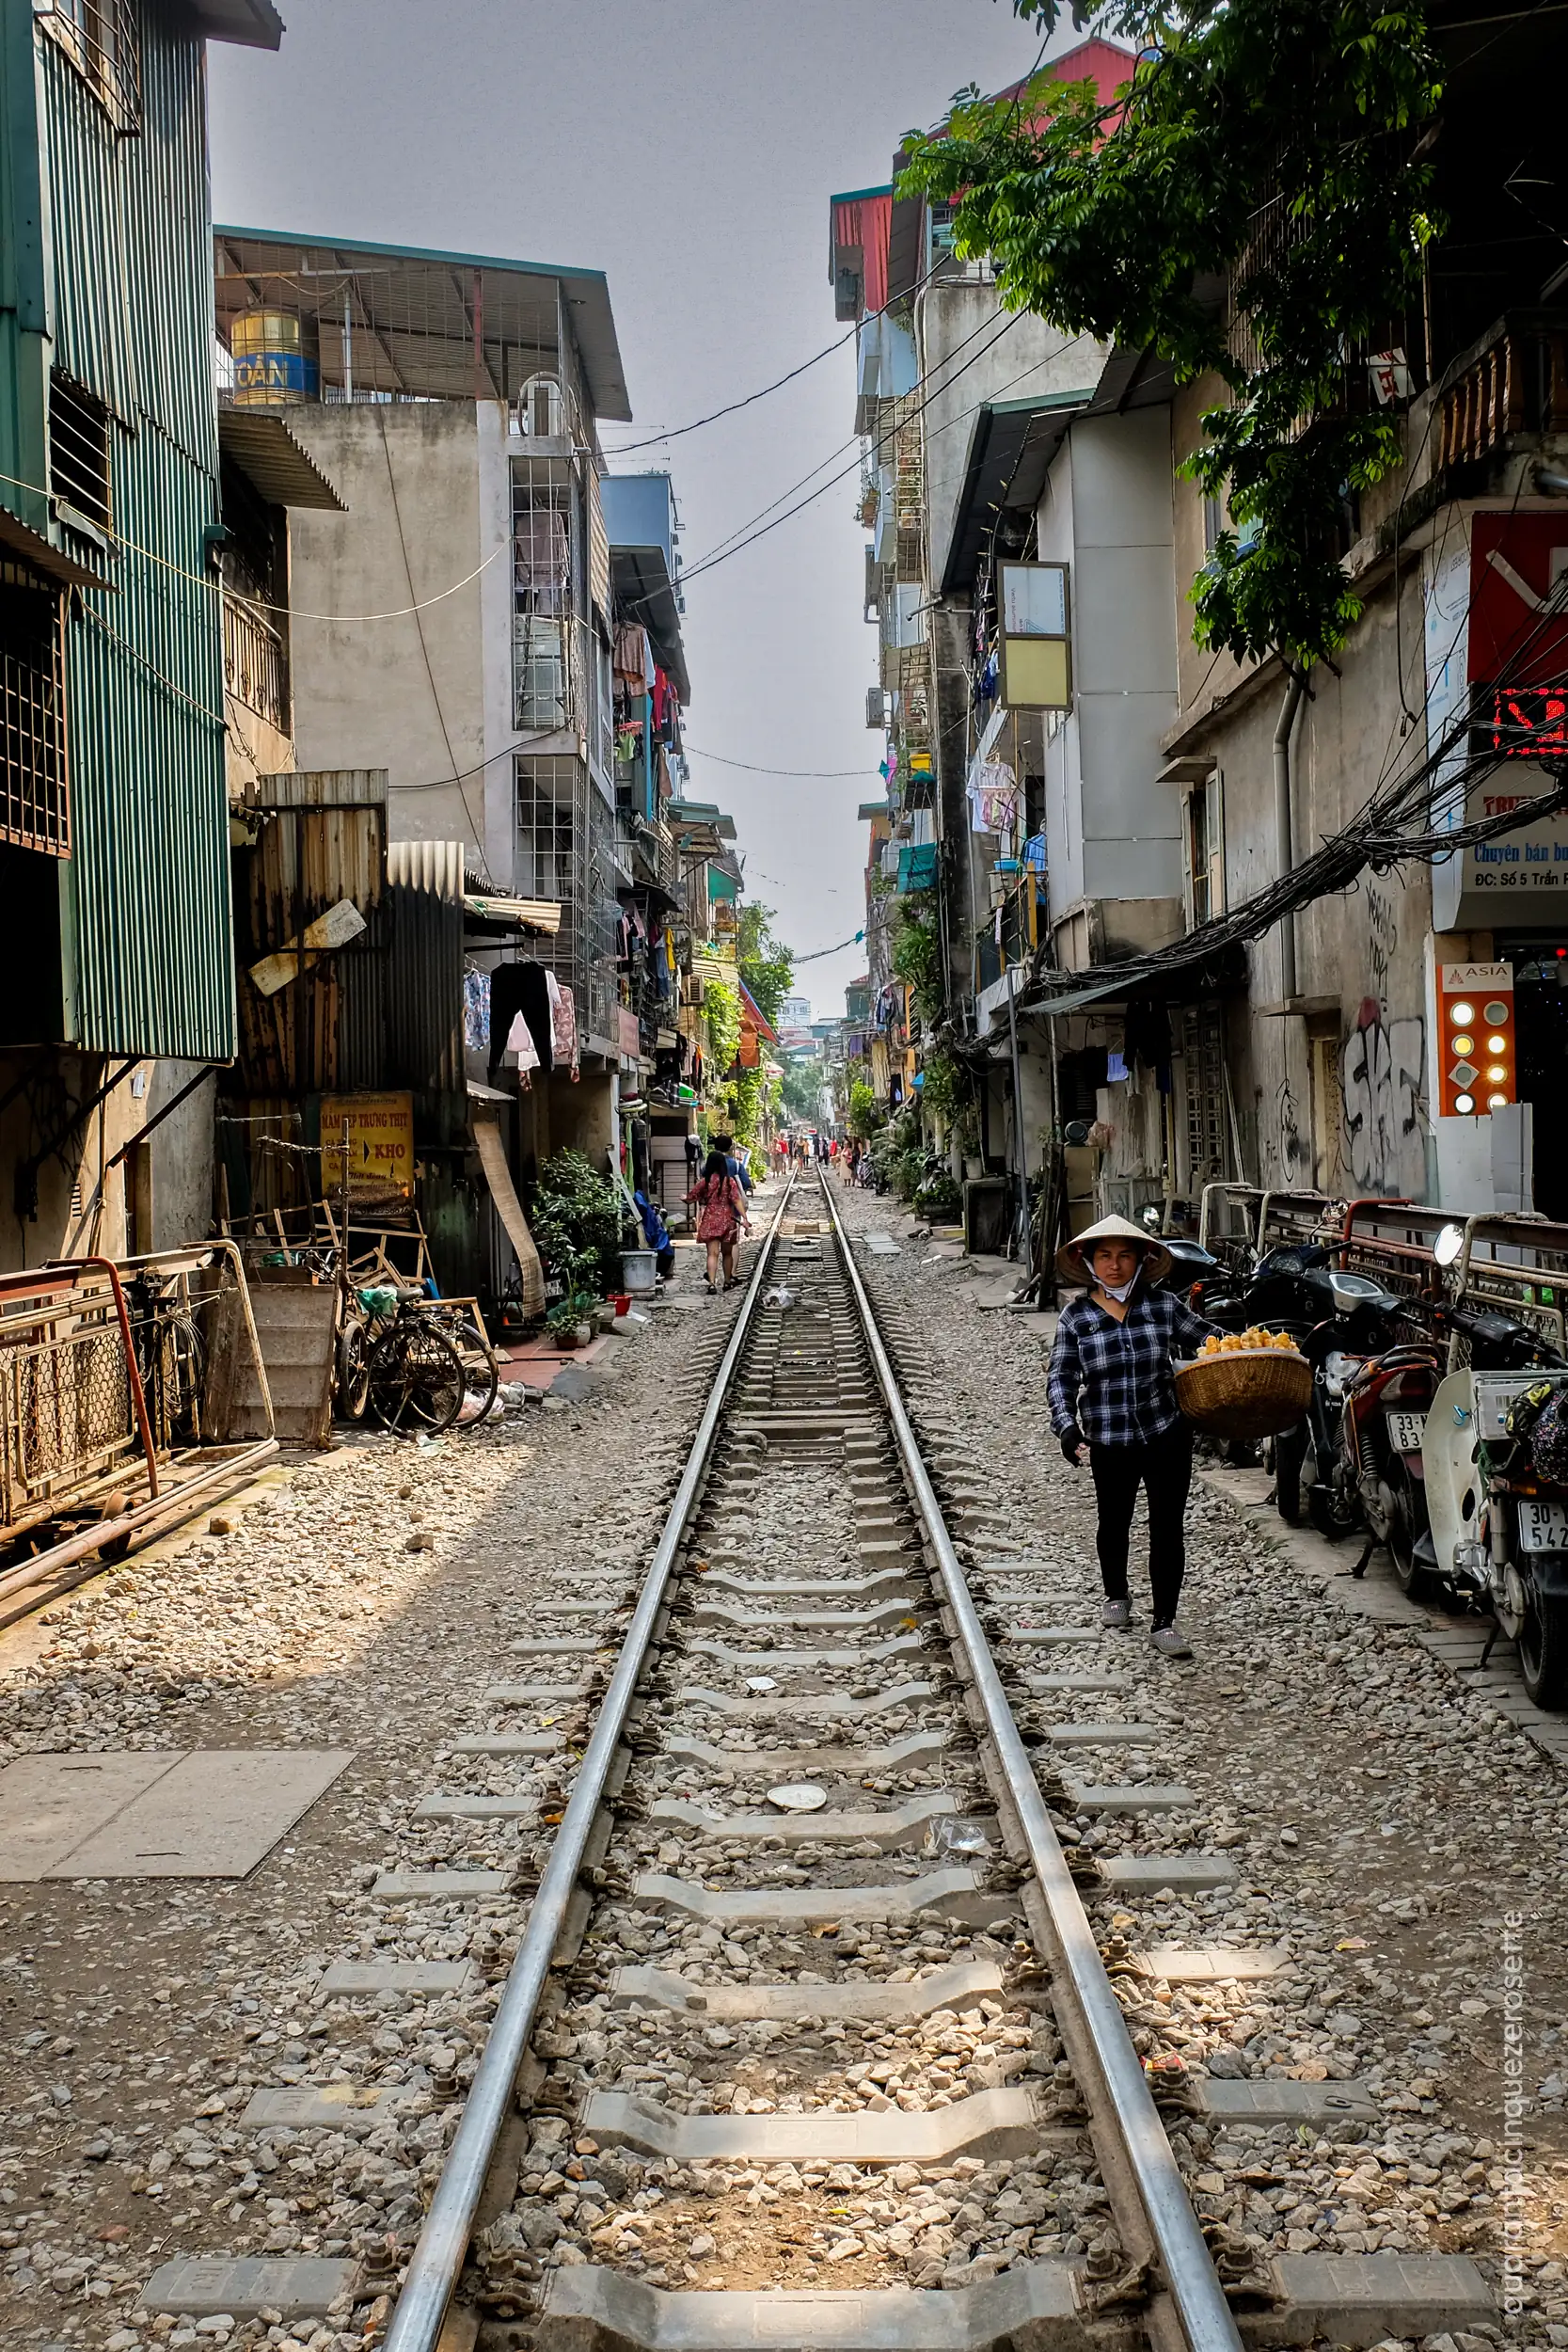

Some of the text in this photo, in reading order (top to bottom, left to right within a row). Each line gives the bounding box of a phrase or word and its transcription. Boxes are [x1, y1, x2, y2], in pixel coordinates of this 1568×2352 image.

[1474, 843, 1520, 866] Chuyên
[1525, 843, 1549, 862] bán
[1475, 874, 1497, 886] ĐC:
[1500, 870, 1517, 886] Số
[1520, 873, 1528, 885] 5
[1531, 869, 1559, 885] Trần
[1465, 966, 1508, 977] ASIA
[373, 1143, 405, 1159] KHO
[1401, 1432, 1424, 1447] 83
[1531, 1527, 1568, 1548] 542
